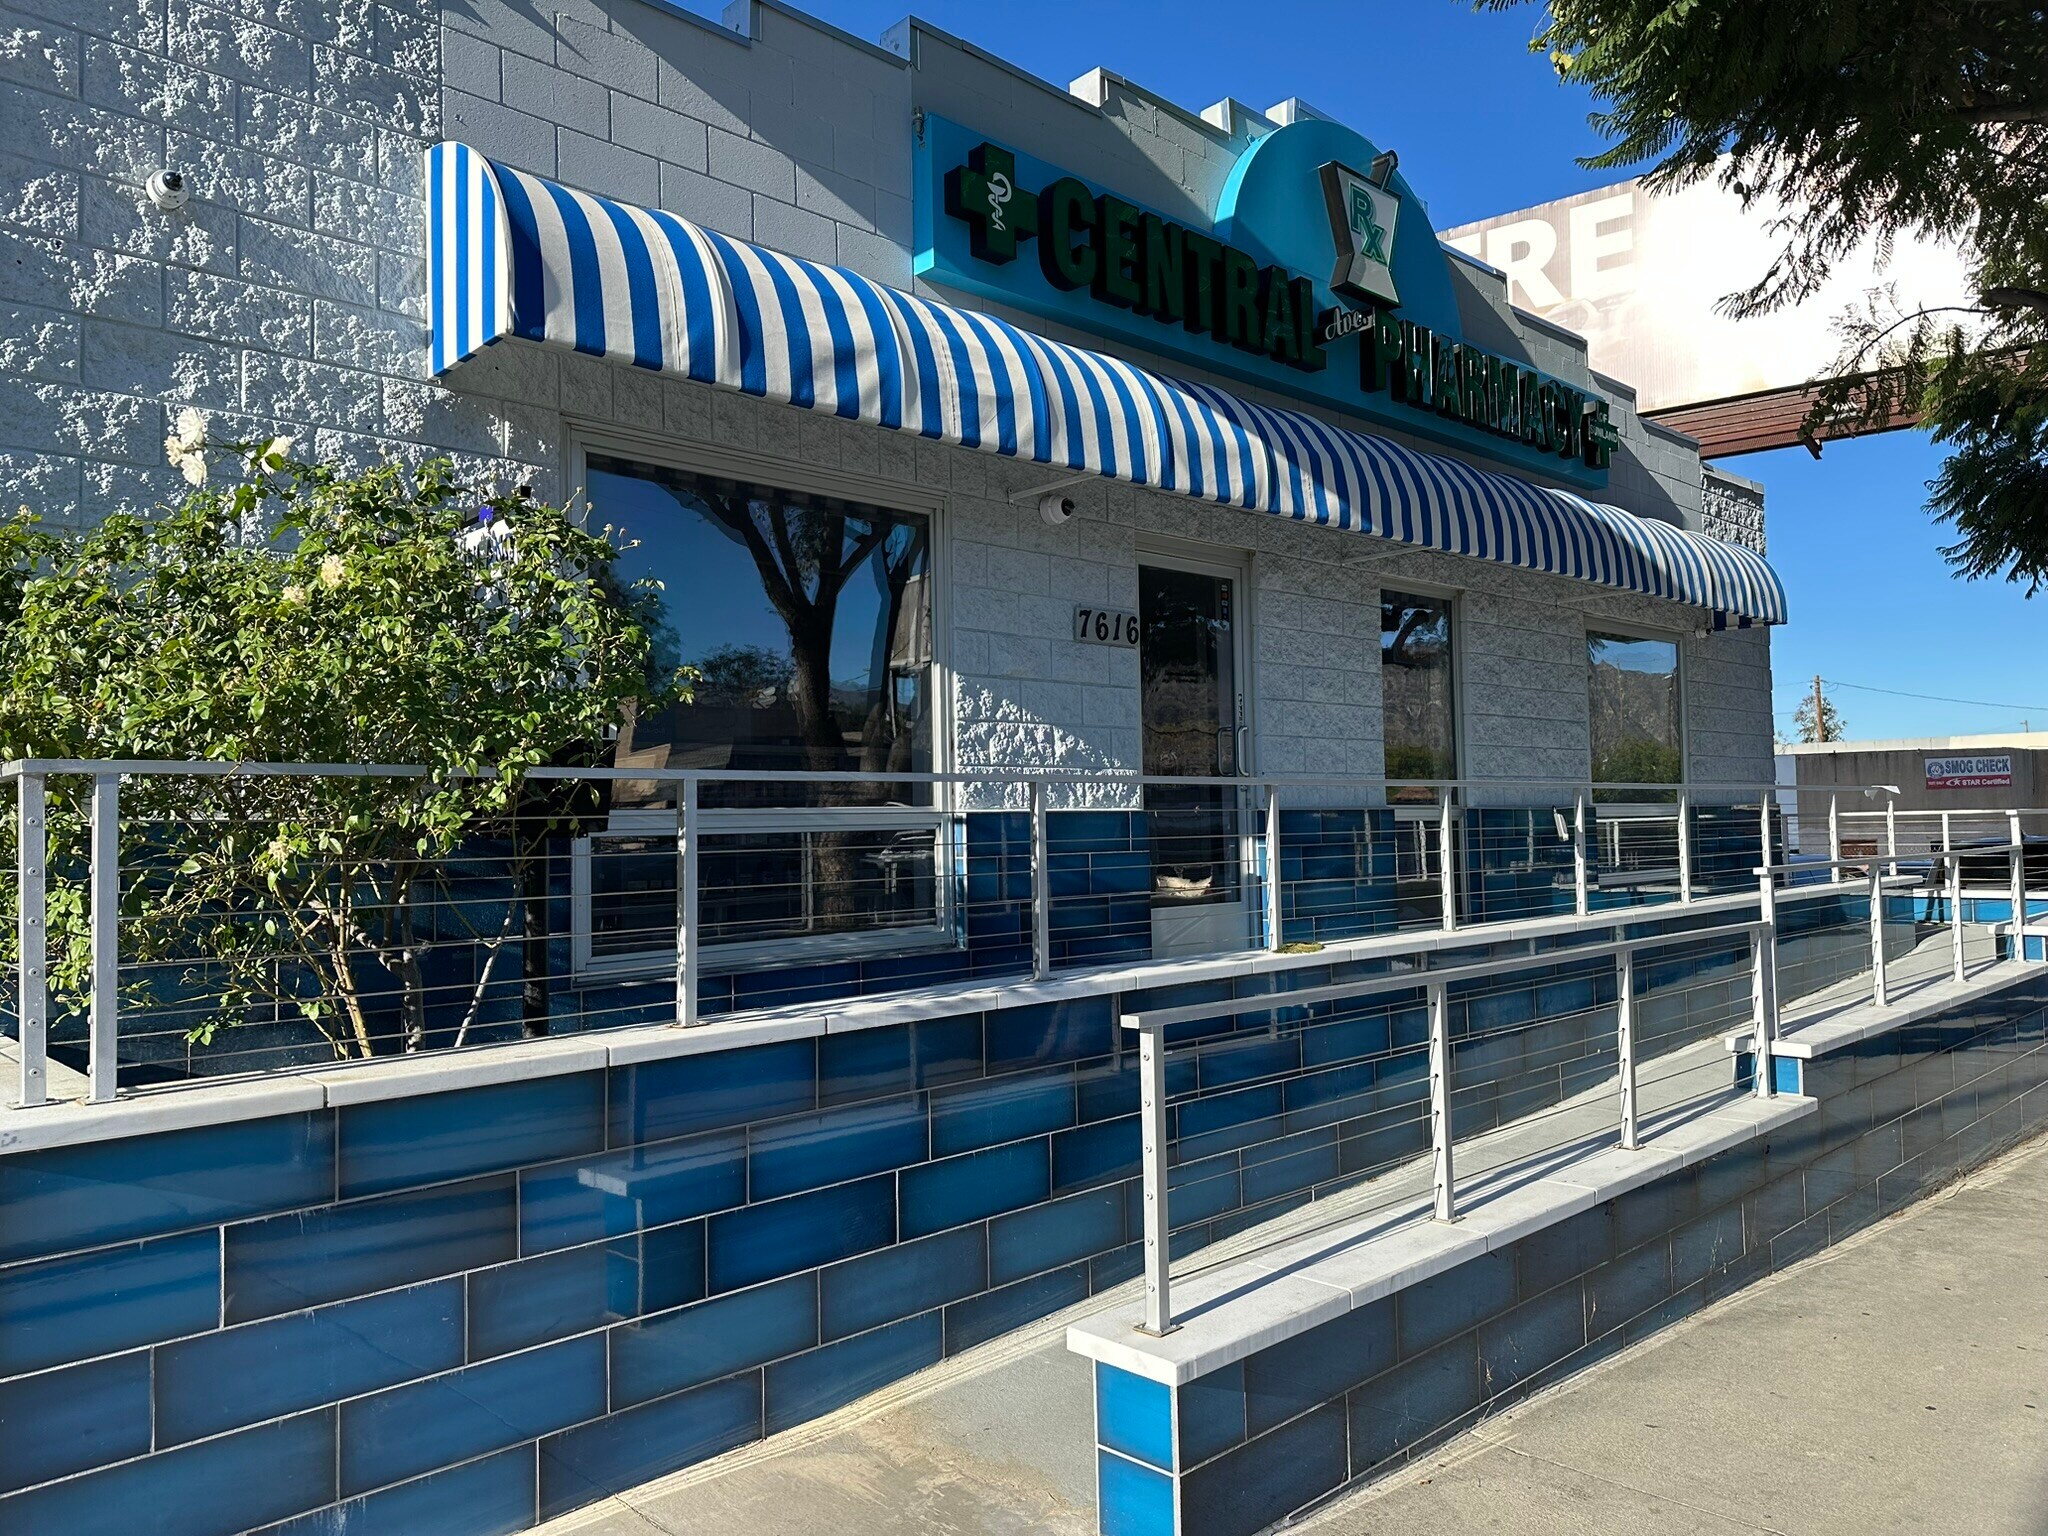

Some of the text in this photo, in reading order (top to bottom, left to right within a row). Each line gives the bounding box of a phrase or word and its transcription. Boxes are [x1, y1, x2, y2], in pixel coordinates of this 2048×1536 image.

[1037, 177, 1327, 373] CENTRAL
[1361, 306, 1586, 459] PHARMACY
[1079, 609, 1139, 645] 7616
[1945, 759, 1973, 774] SMOG
[1975, 758, 2009, 773] CHECK
[1962, 778, 1980, 786] STAR
